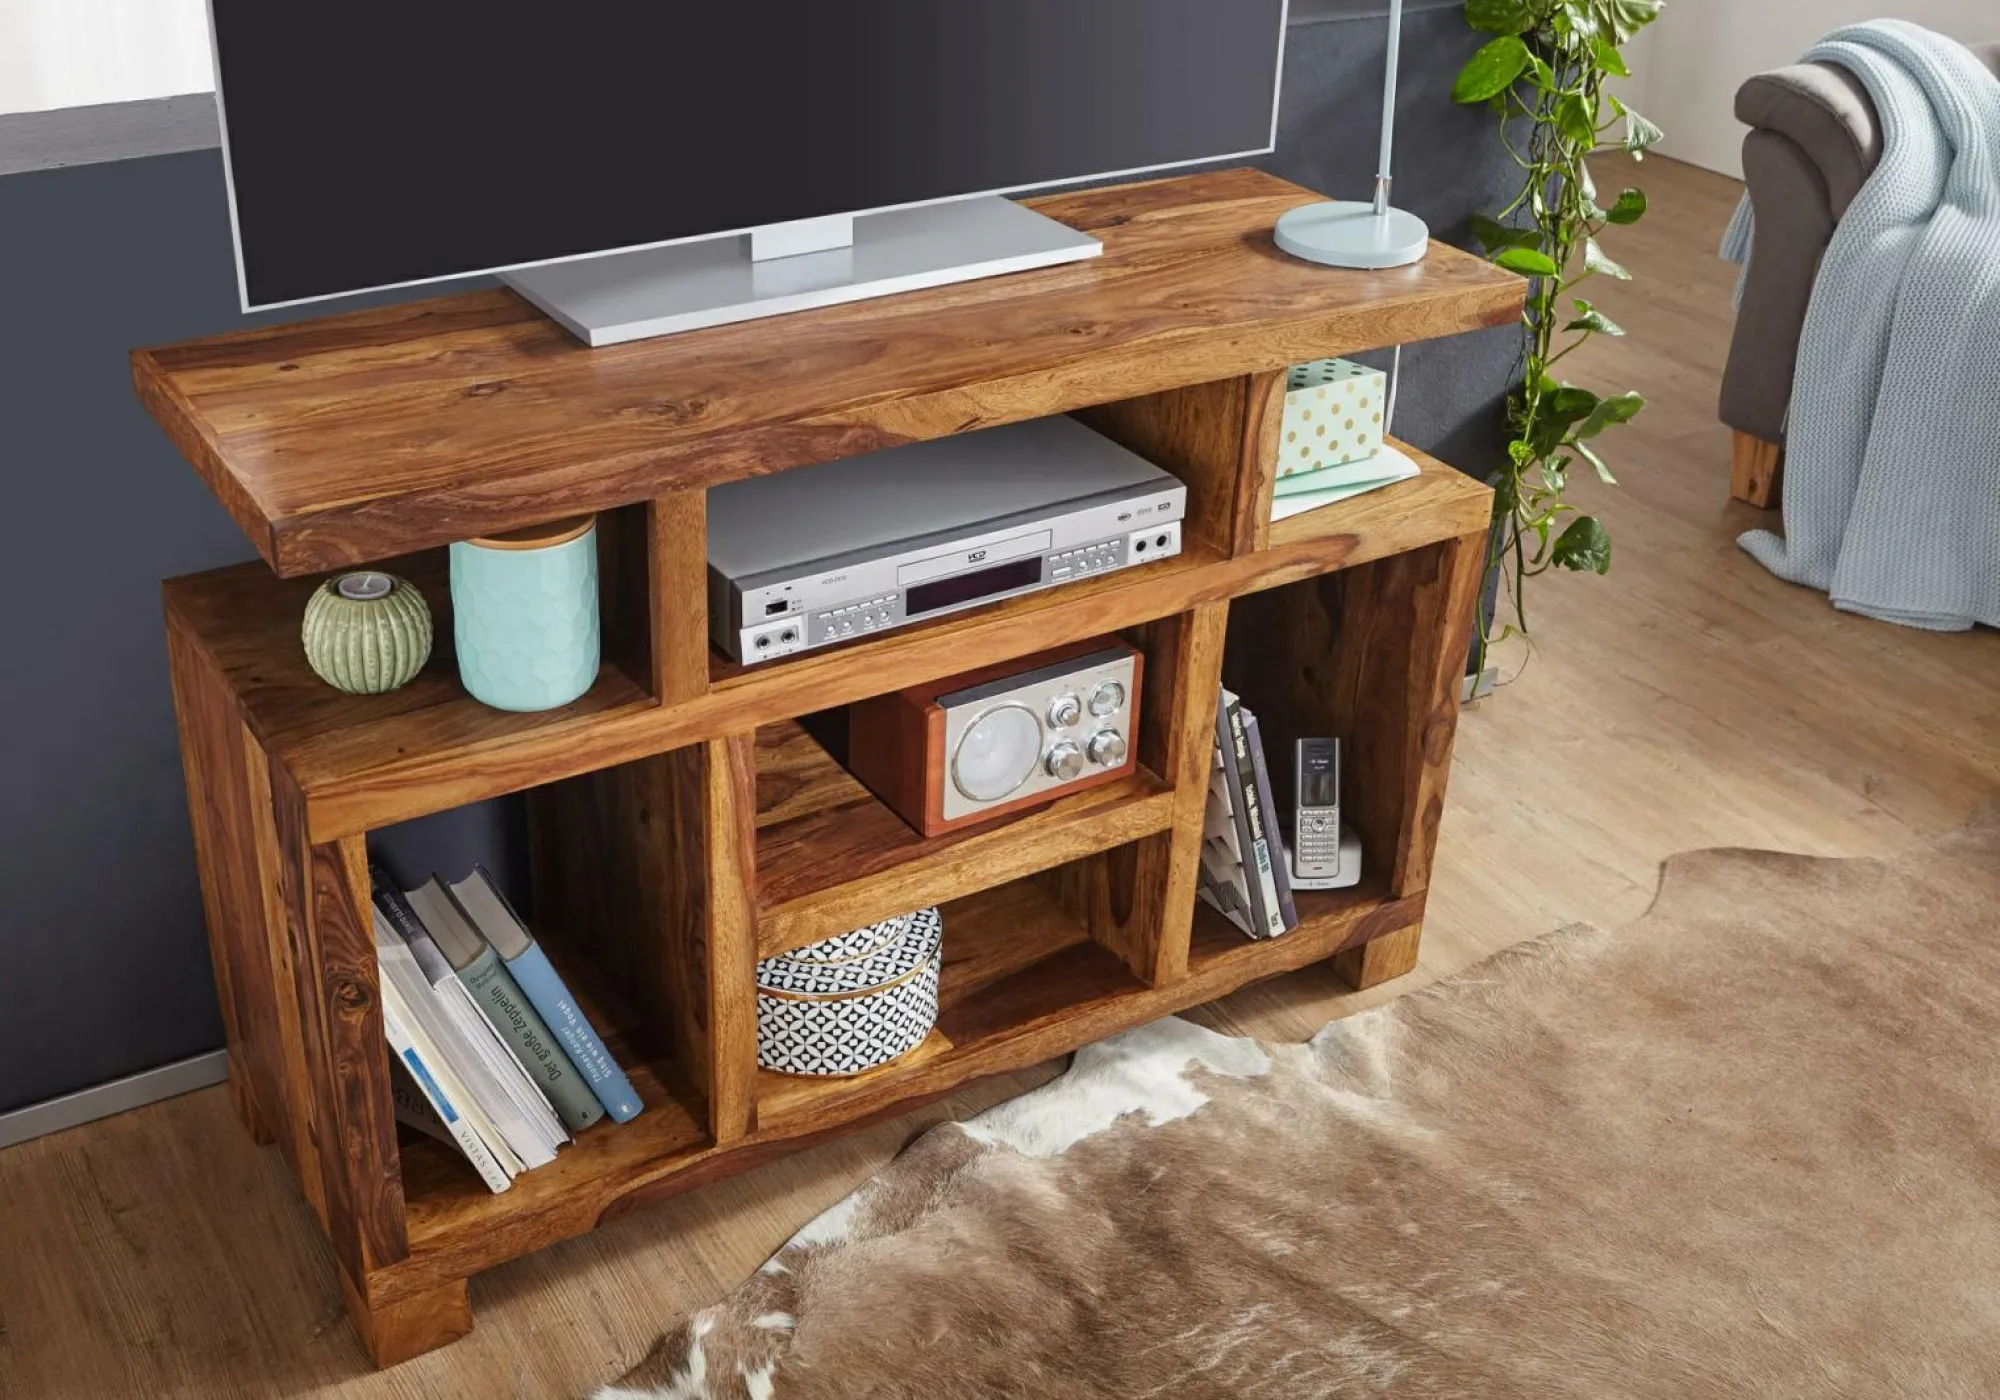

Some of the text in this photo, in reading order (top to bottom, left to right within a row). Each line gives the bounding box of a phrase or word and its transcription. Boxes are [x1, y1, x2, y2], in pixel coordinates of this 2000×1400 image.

[557, 1000, 576, 1026] Vogel
[490, 985, 562, 1081] Der große Zeppelin
[576, 1025, 588, 1041] ein
[587, 1042, 599, 1058] wie
[580, 1052, 603, 1084] Thomas
